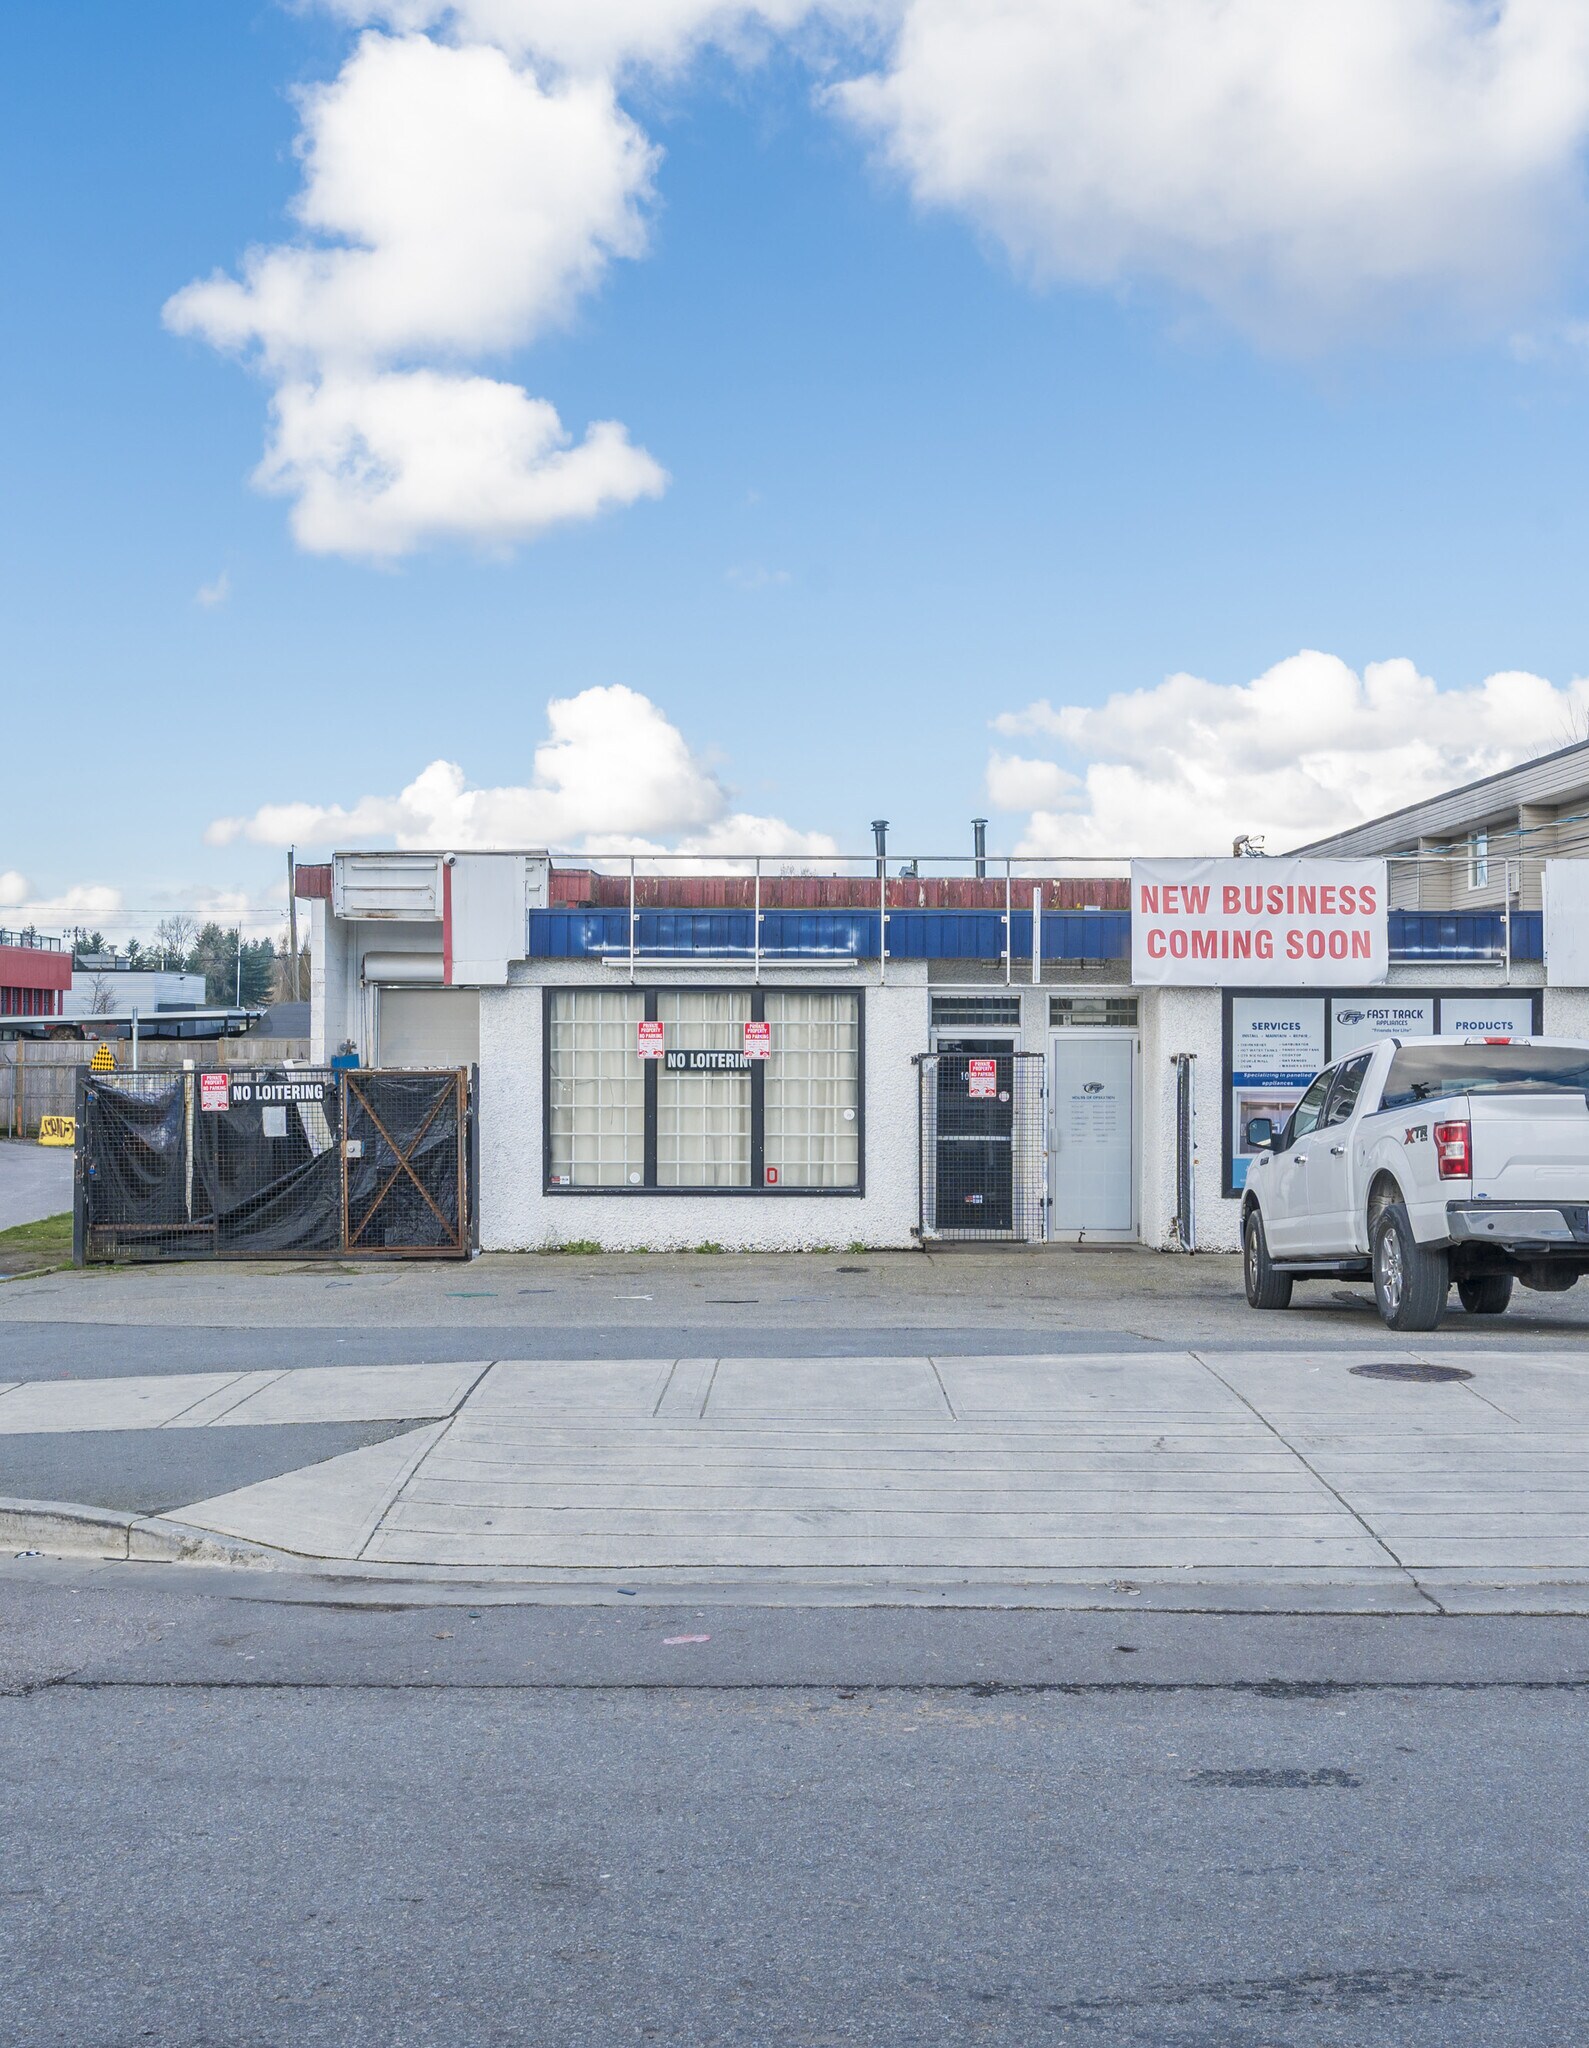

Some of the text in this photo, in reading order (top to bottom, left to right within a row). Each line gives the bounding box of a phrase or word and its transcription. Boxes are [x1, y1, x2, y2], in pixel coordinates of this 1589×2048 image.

[1140, 885, 1377, 915] NEW BUSINESS
[1147, 929, 1371, 960] COMING SOON
[1366, 1009, 1424, 1019] FAST TRACK
[1252, 1022, 1301, 1031] SERVICES
[1455, 1021, 1514, 1030] PRODUCTS
[667, 1053, 752, 1068] NO LOITERIN
[233, 1085, 252, 1100] NO
[255, 1084, 323, 1100] LOITERING
[1404, 1124, 1428, 1145] XTR
